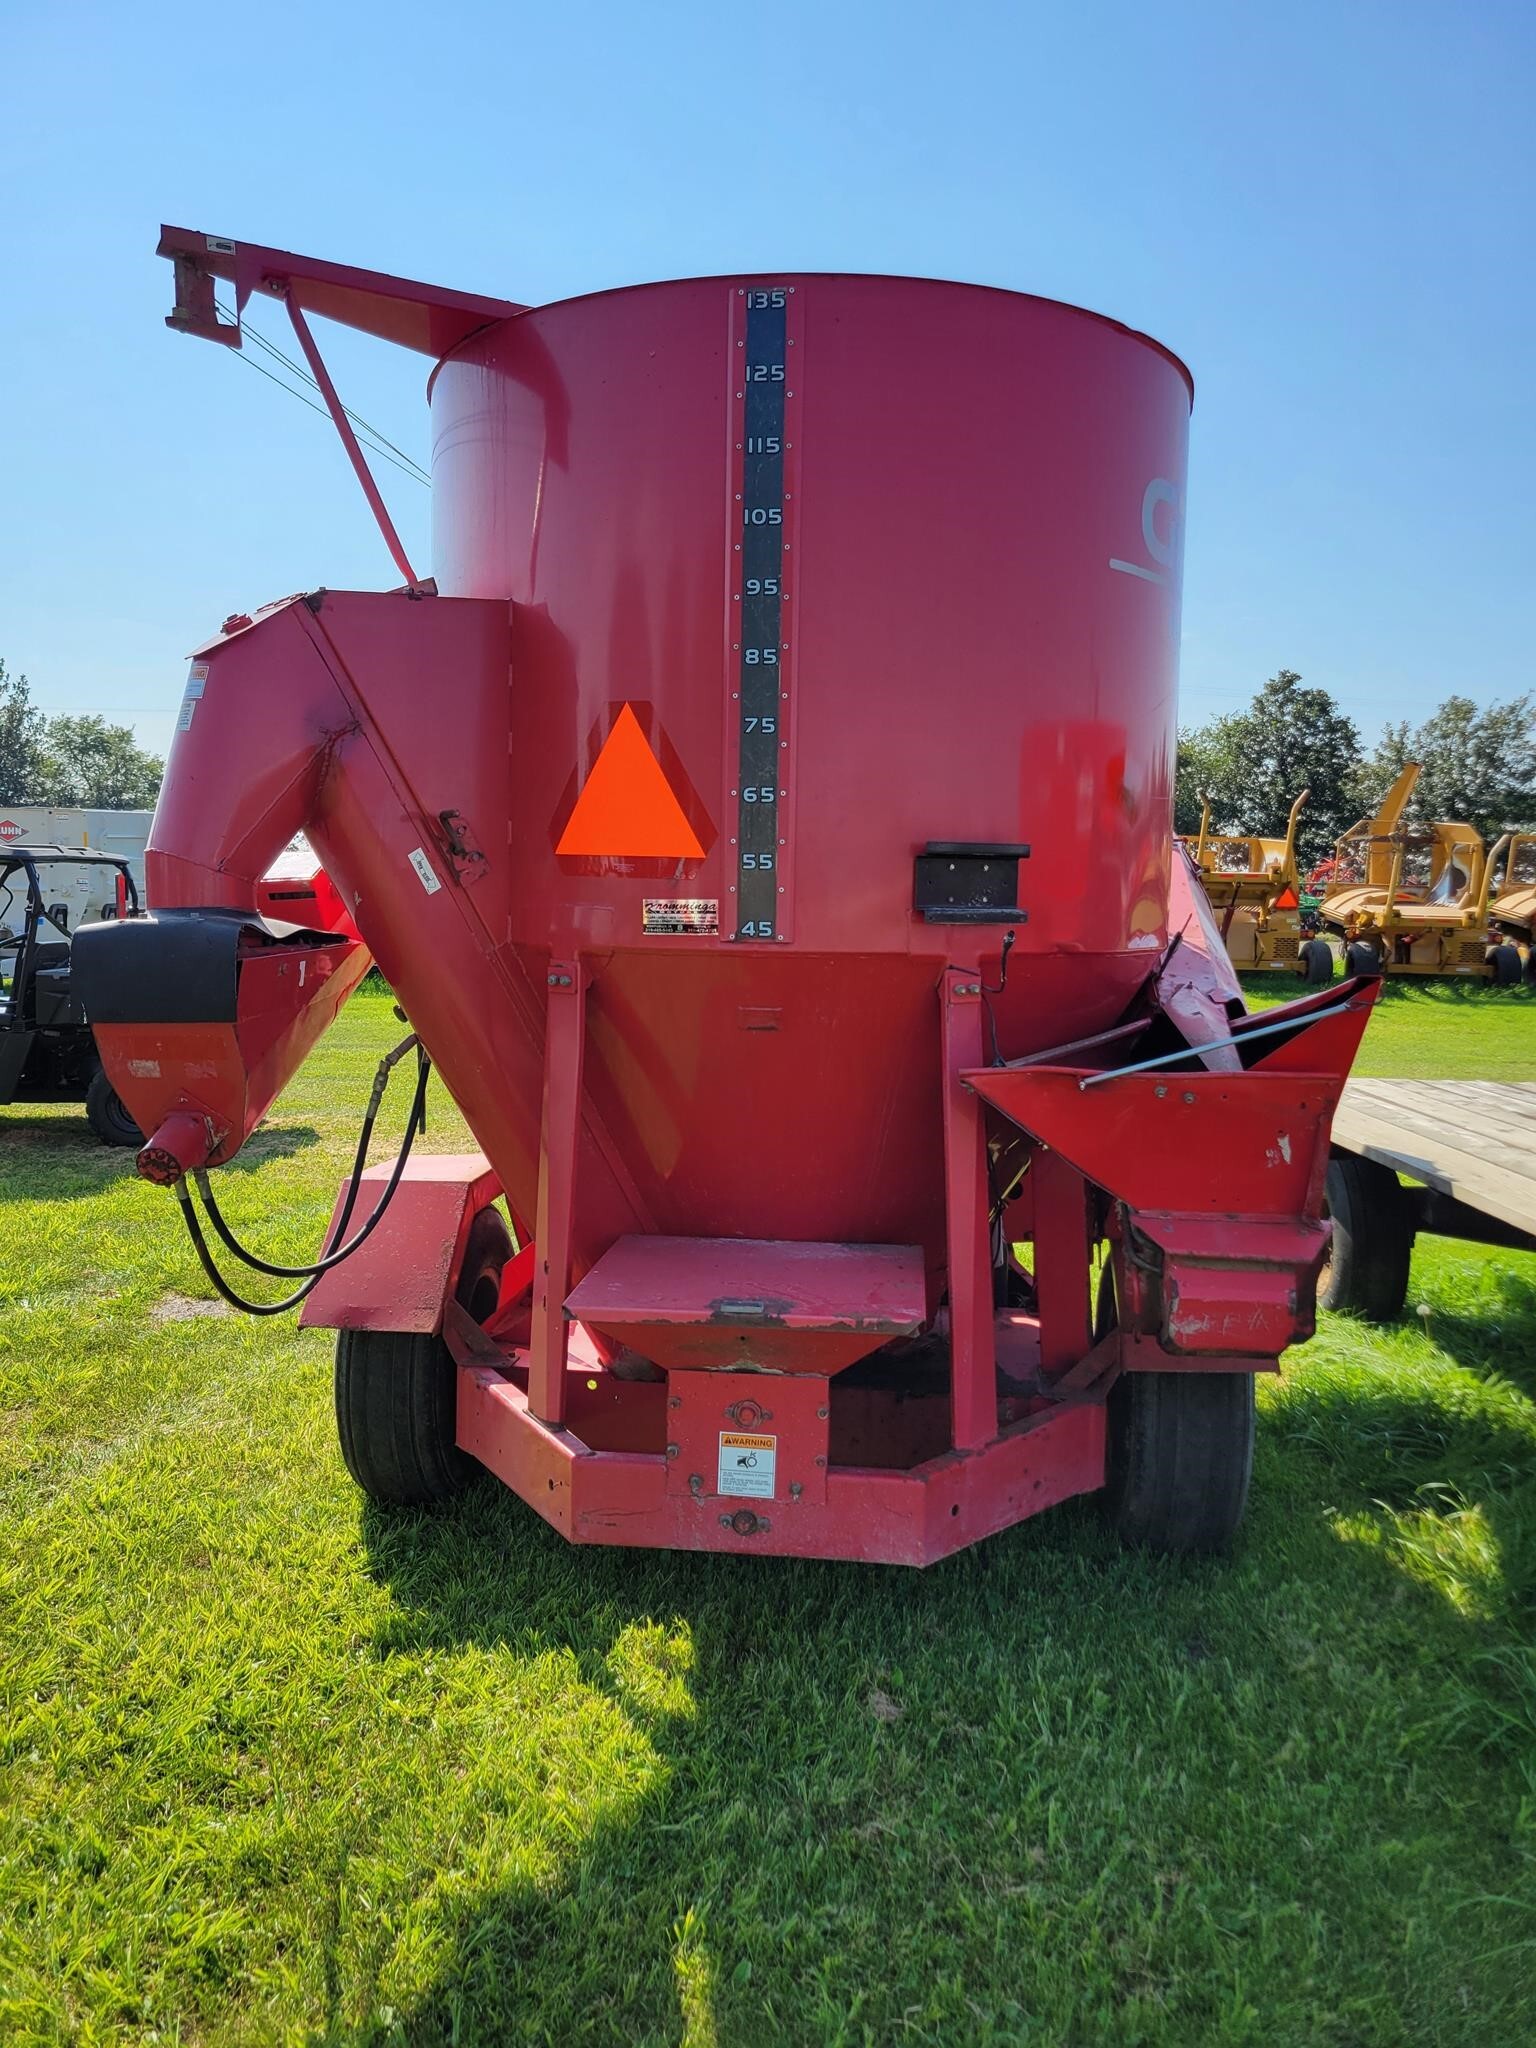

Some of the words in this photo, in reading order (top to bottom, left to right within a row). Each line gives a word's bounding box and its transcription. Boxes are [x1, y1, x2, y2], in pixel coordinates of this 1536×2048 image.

[747, 292, 785, 309] 135
[746, 365, 785, 382] 125
[748, 437, 780, 453] 115
[744, 508, 782, 525] 105
[746, 579, 778, 595] 95
[745, 648, 777, 664] 85
[744, 717, 775, 733] 75
[743, 787, 774, 803] 65
[0, 826, 22, 835] UHN
[742, 854, 773, 869] 55
[644, 902, 717, 914] Kromminga
[741, 921, 772, 937] 45
[731, 1437, 773, 1447] WARNING
